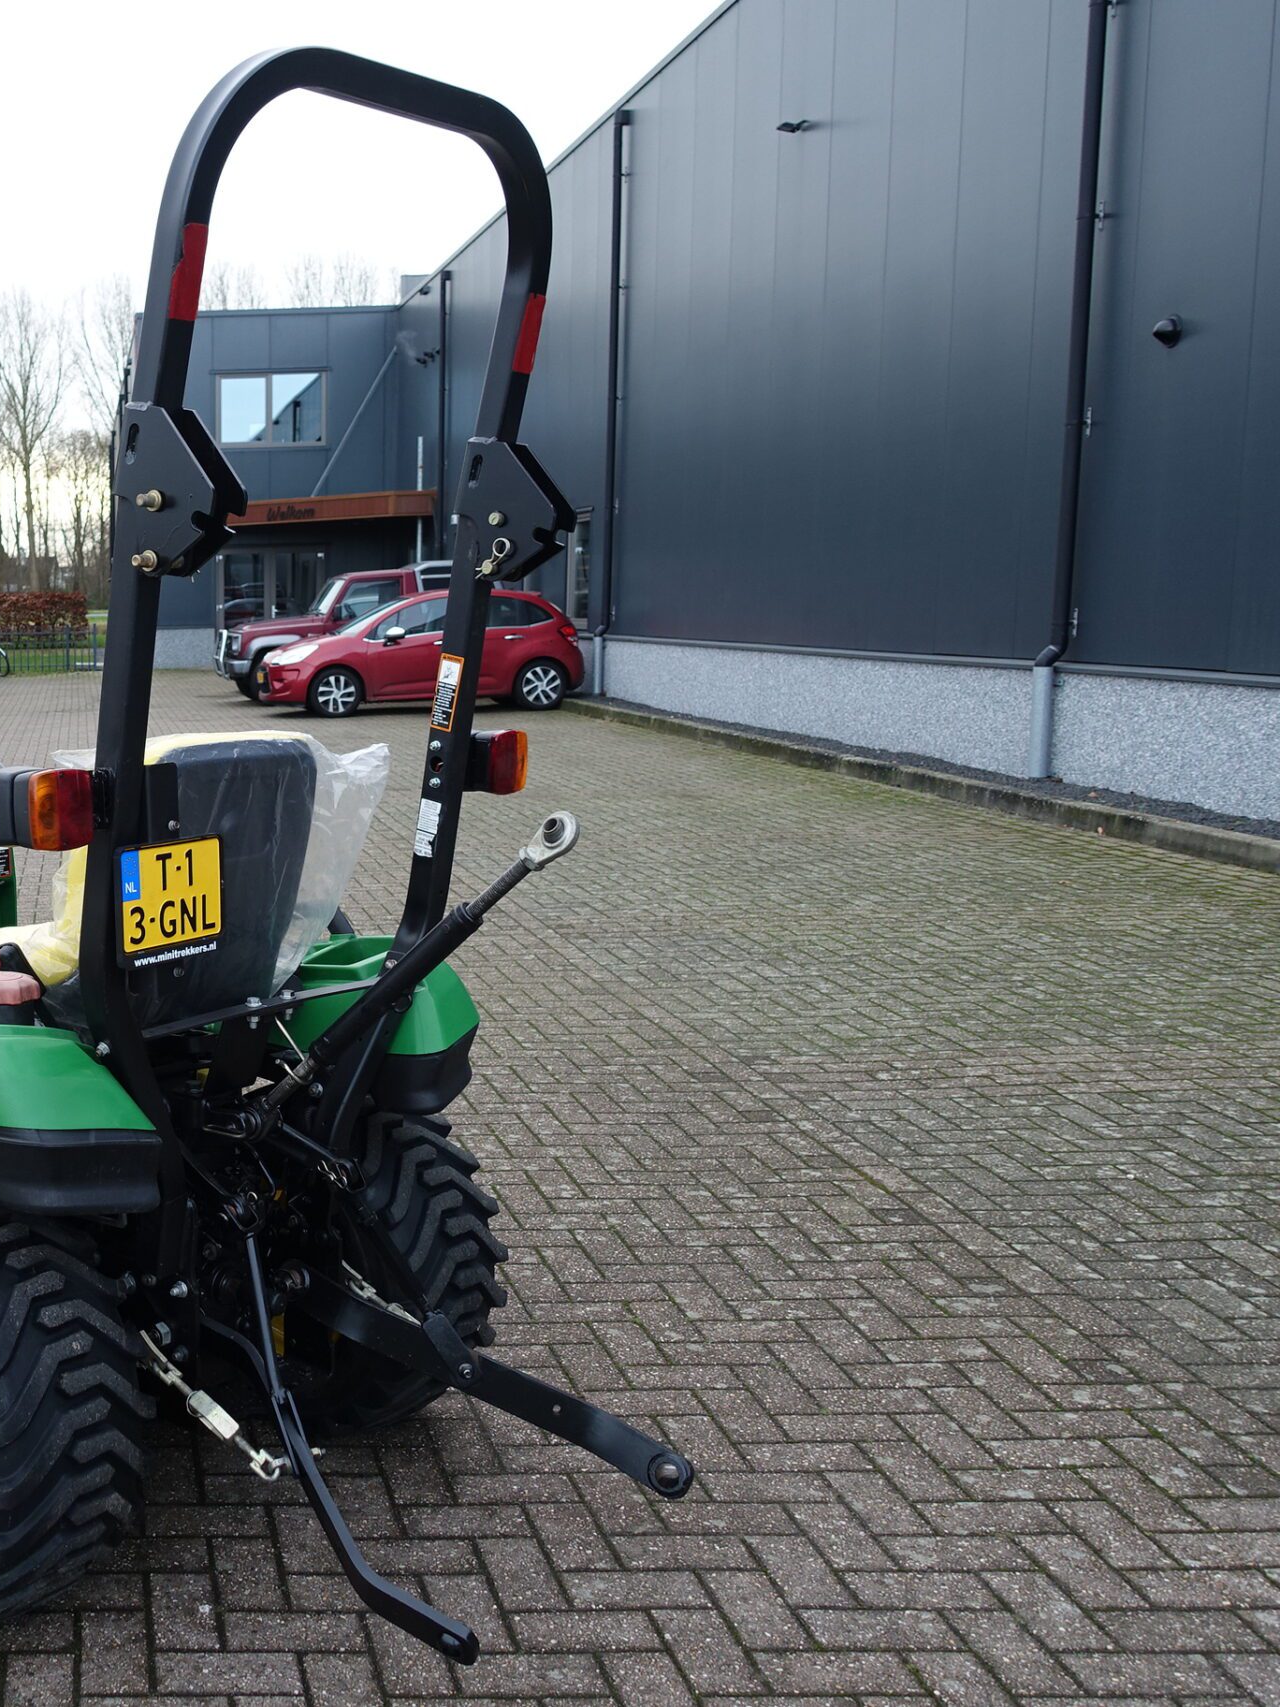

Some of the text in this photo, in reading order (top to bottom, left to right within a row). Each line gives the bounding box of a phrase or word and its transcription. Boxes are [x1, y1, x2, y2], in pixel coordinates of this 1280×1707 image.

[124, 881, 138, 894] NL
[155, 848, 194, 892] T-1
[129, 893, 217, 945] 3-GNL
[133, 940, 217, 967] www.minitrekkers.nl
